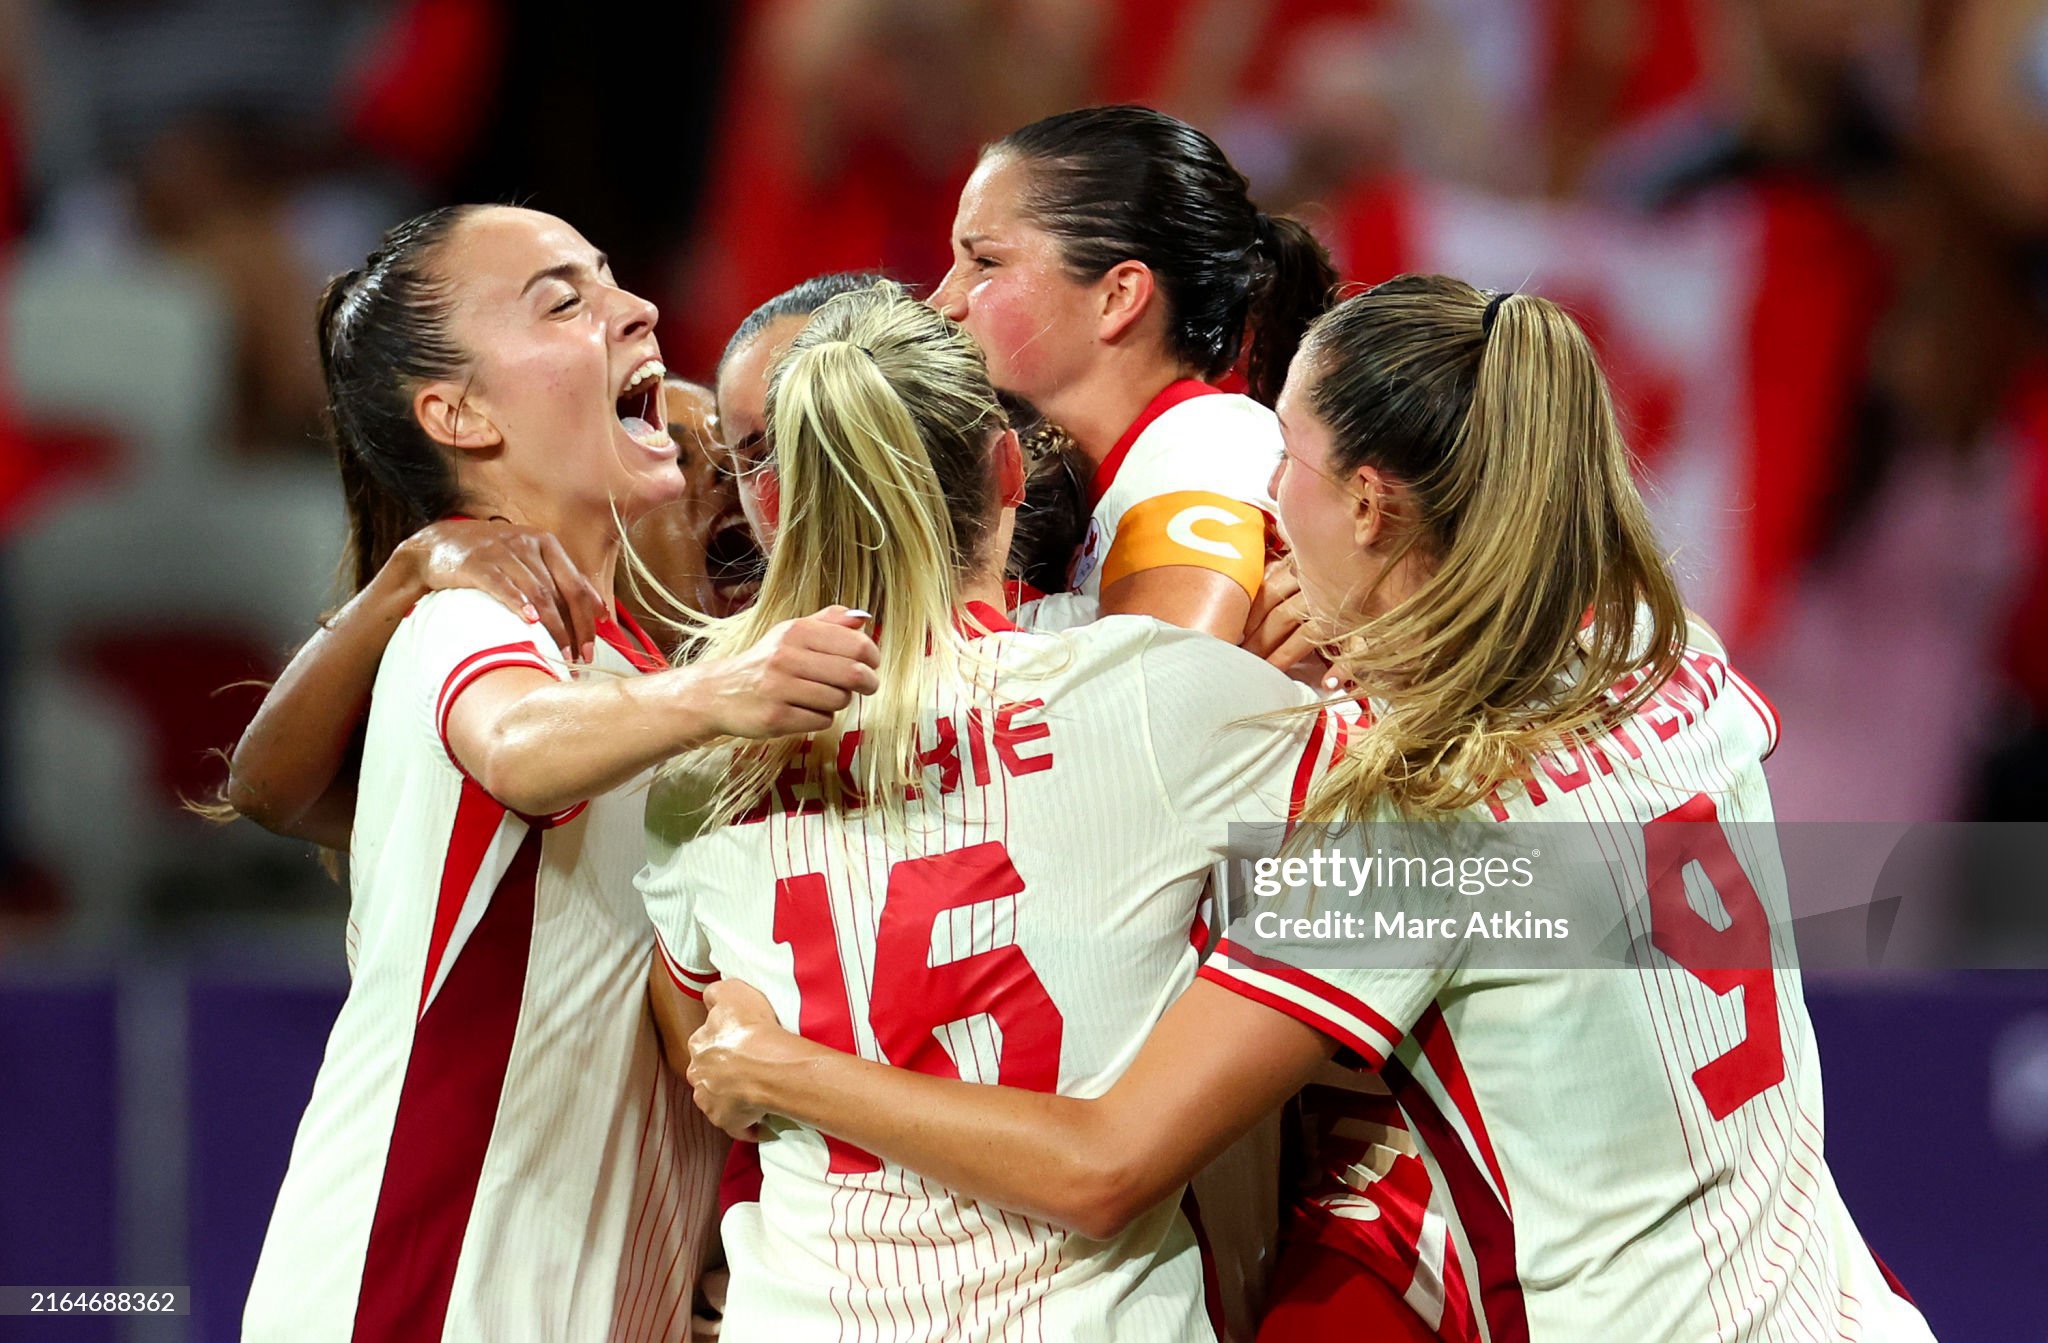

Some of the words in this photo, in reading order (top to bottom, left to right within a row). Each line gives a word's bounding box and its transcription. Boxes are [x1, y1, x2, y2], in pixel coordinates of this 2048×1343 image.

[1166, 505, 1245, 560] C
[772, 840, 1064, 1175] 16
[1642, 792, 1786, 1122] 9
